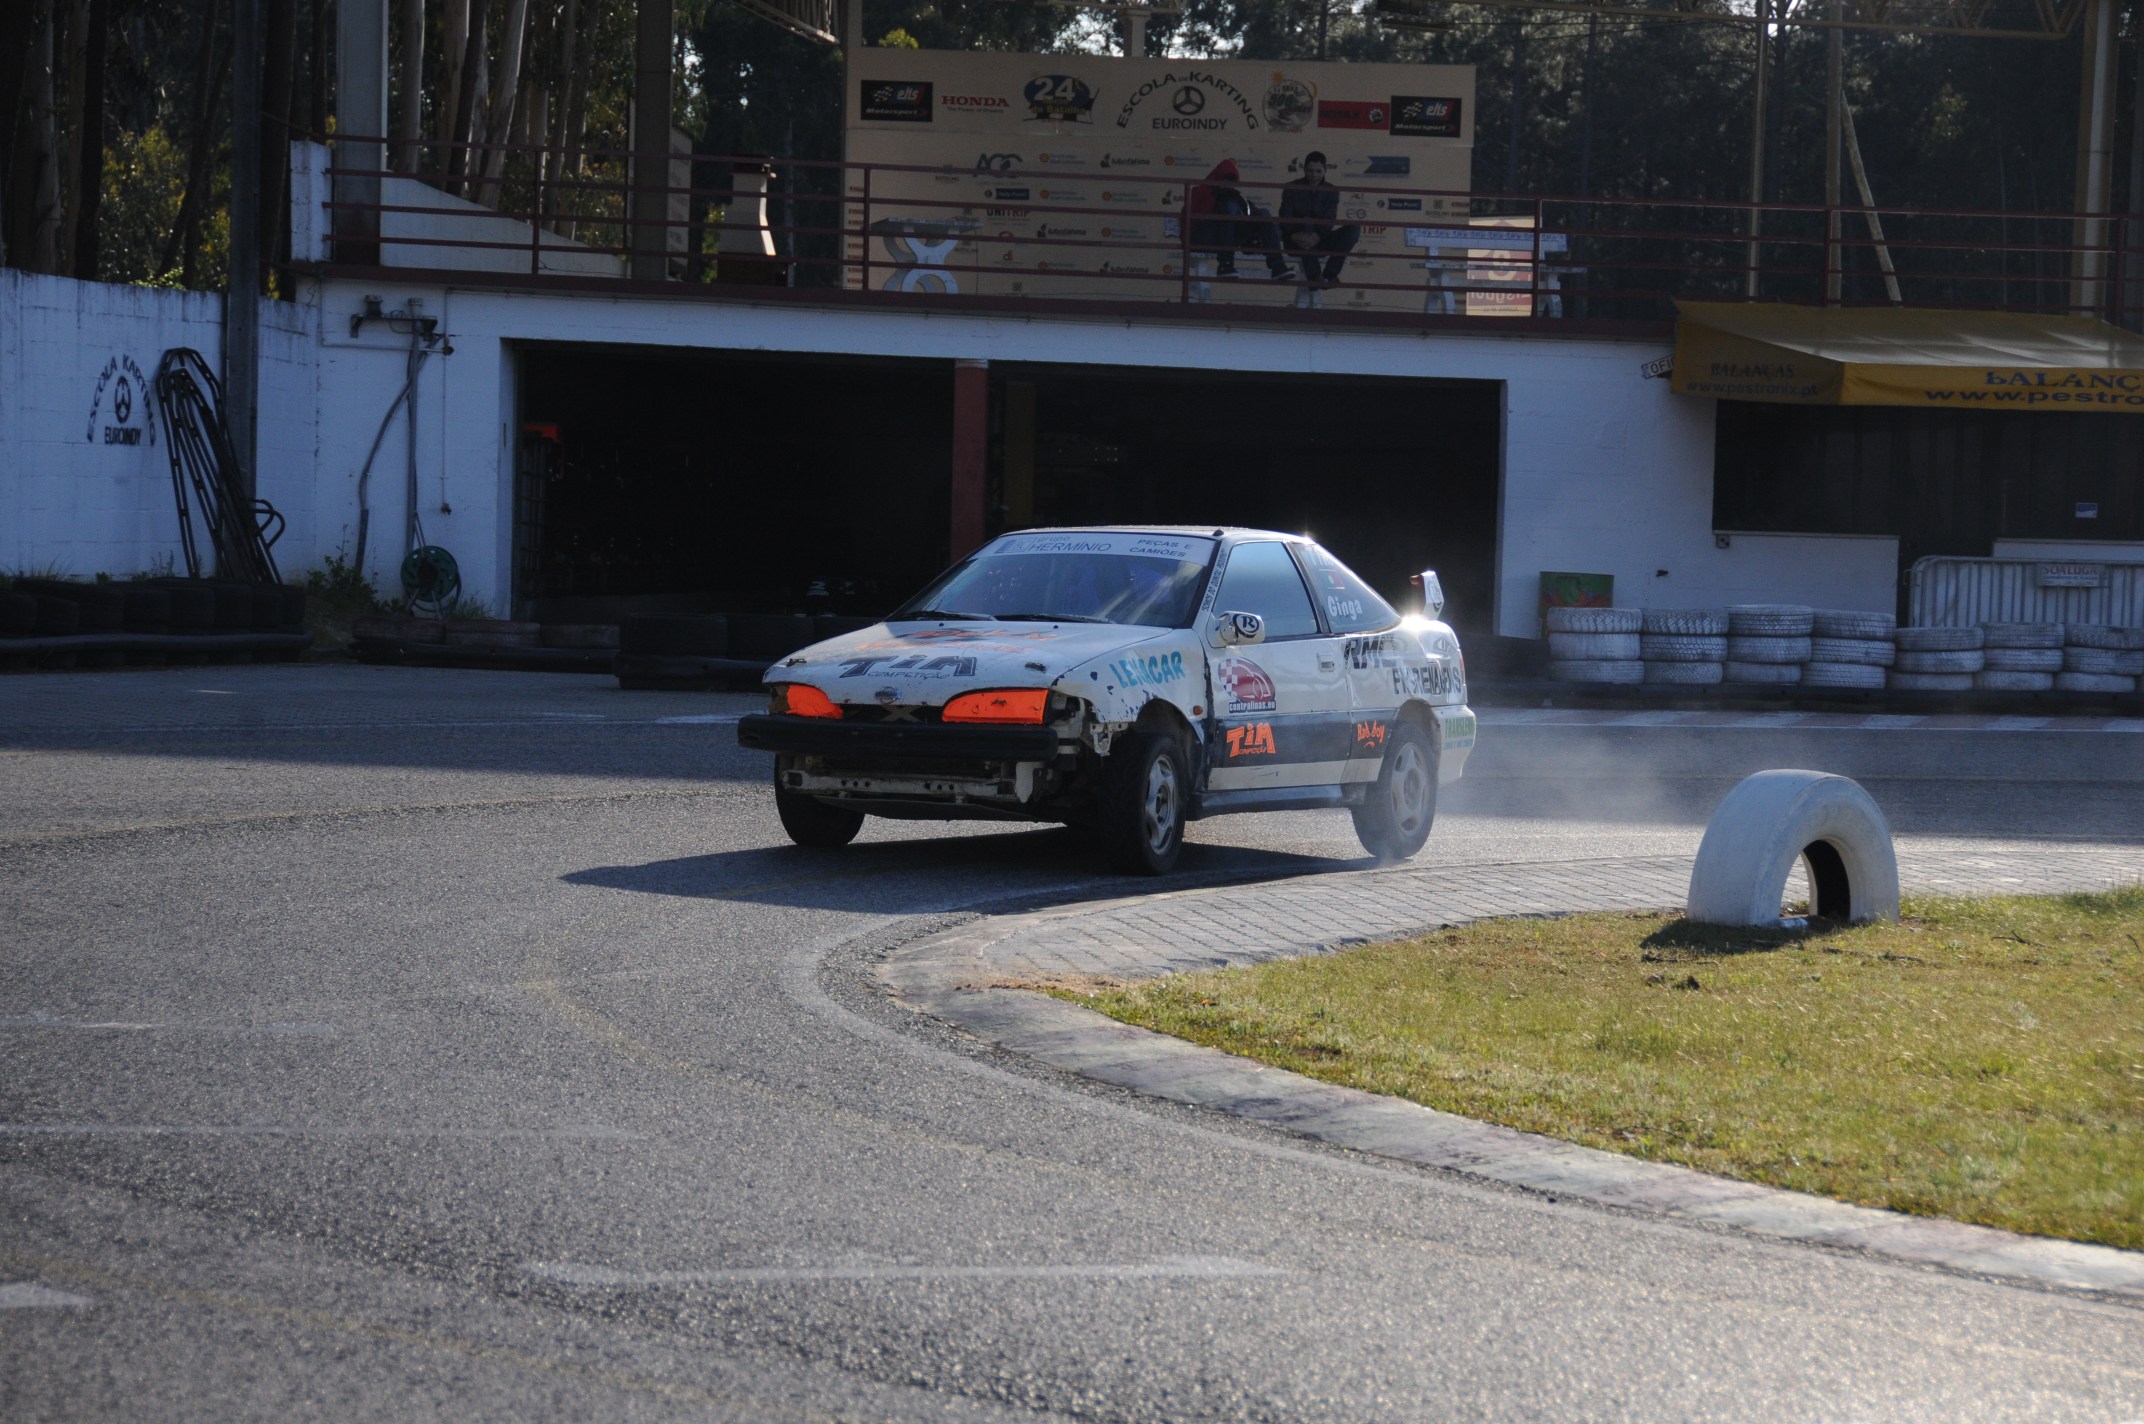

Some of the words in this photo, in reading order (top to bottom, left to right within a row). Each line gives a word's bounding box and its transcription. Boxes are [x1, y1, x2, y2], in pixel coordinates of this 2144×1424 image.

[1034, 77, 1077, 102] 24
[941, 95, 1010, 107] HONDA
[1116, 73, 1177, 129] ESCOLA
[1189, 71, 1260, 130] KARTING
[865, 107, 918, 116] Motorsport
[1152, 118, 1228, 130] EUROINDY
[1394, 123, 1447, 132] Motorsport
[1711, 363, 1795, 379] BALANÇAS
[1686, 382, 1818, 397] www.pestronix.pt
[105, 426, 142, 446] EUROINDY
[1136, 538, 1179, 548] PEÇAS
[1128, 546, 1187, 557] CAMIÕES
[1327, 595, 1363, 621] Ginga
